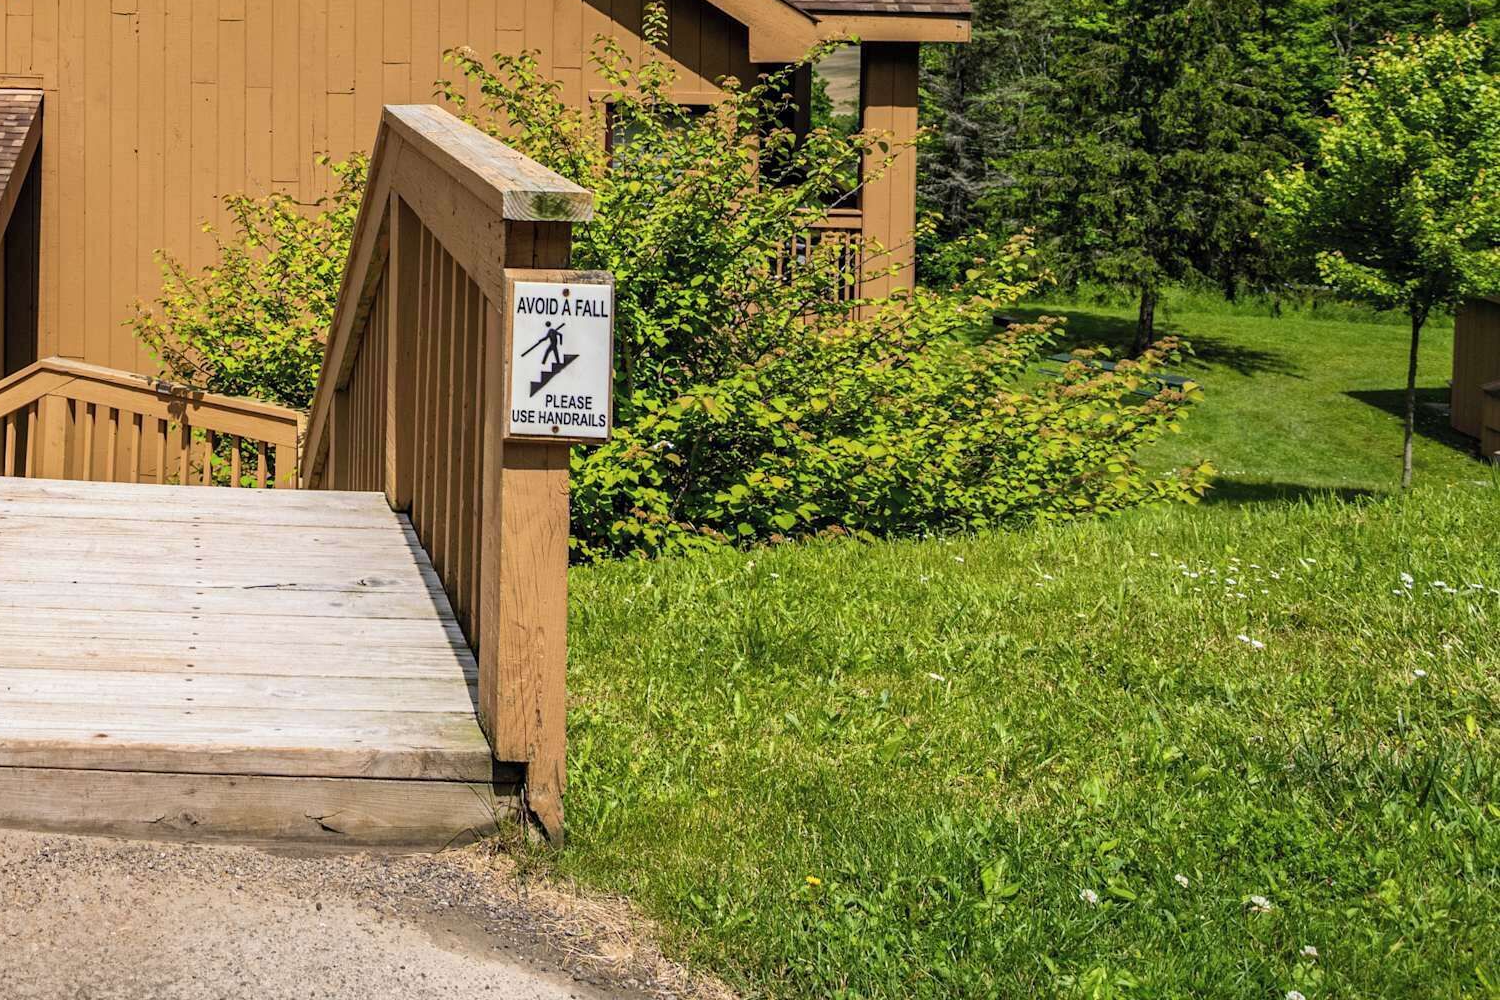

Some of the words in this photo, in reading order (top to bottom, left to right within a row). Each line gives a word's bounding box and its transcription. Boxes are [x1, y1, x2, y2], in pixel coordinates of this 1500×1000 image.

[516, 297, 559, 315] AVOID
[561, 298, 572, 316] A
[575, 299, 609, 318] FALL
[545, 394, 593, 410] PLEASE
[512, 409, 535, 423] USE
[538, 411, 606, 427] HANDRAILS
